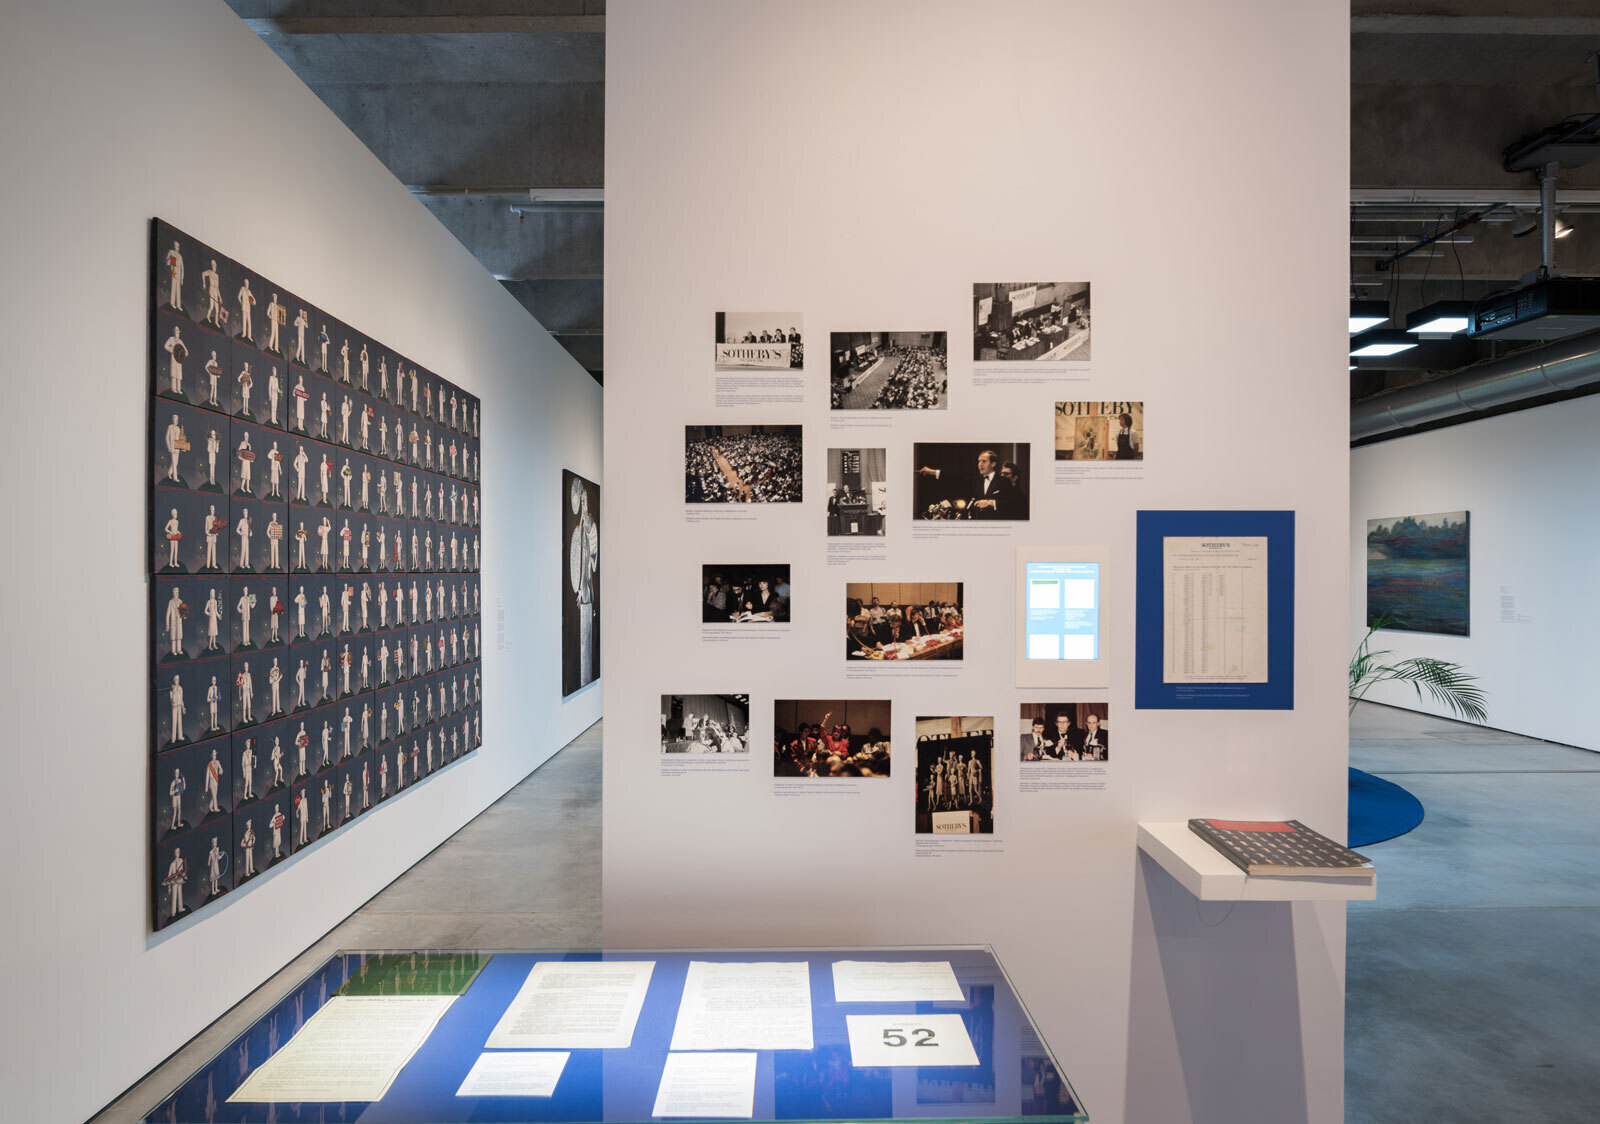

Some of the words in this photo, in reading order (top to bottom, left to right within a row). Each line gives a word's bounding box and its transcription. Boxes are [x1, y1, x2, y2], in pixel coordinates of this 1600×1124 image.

[722, 348, 782, 359] SOTHEBY'S
[1055, 401, 1143, 416] SOTEBY
[883, 1028, 939, 1047] 52
